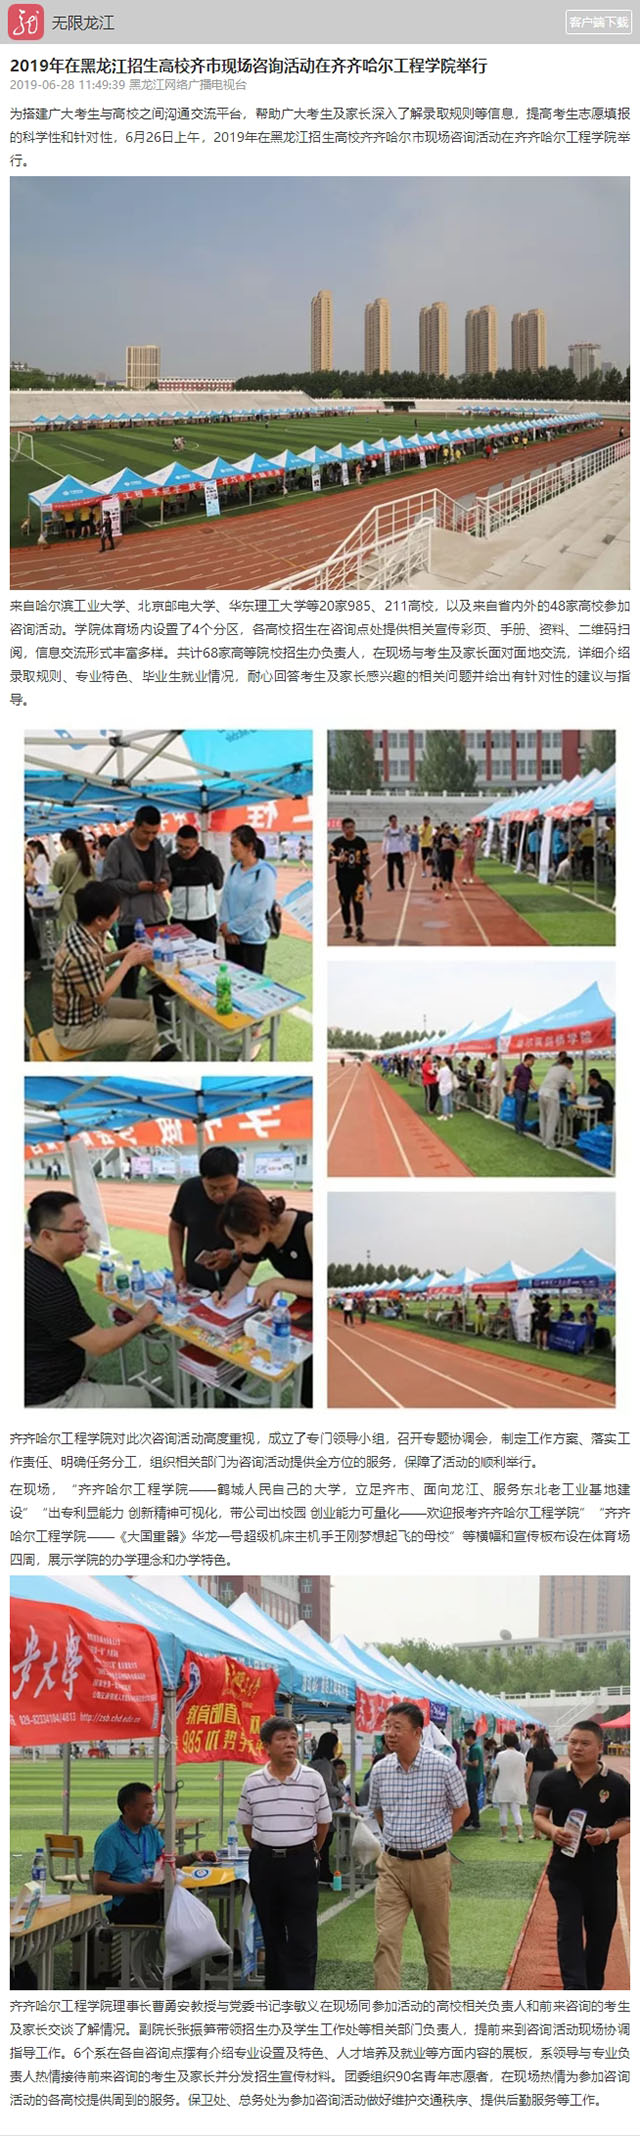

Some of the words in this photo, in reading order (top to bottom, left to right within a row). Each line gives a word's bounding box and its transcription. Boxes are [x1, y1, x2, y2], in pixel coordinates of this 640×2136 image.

[52, 15, 115, 31] 无限龙江
[568, 15, 629, 29] 客户端下载
[10, 57, 488, 75] 2019年在黑龙江招生高校齐市现场咨询活动在齐齐哈尔工程学院举行
[10, 79, 75, 91] 2019-06-28
[79, 79, 126, 91] 11:49:39
[129, 78, 248, 92] 黑龙江网络广播电视台
[9, 154, 28, 168] 行。
[9, 693, 28, 707] 导。
[9, 1552, 232, 1567] 四周，展示学院的办学理念和办学特色。
